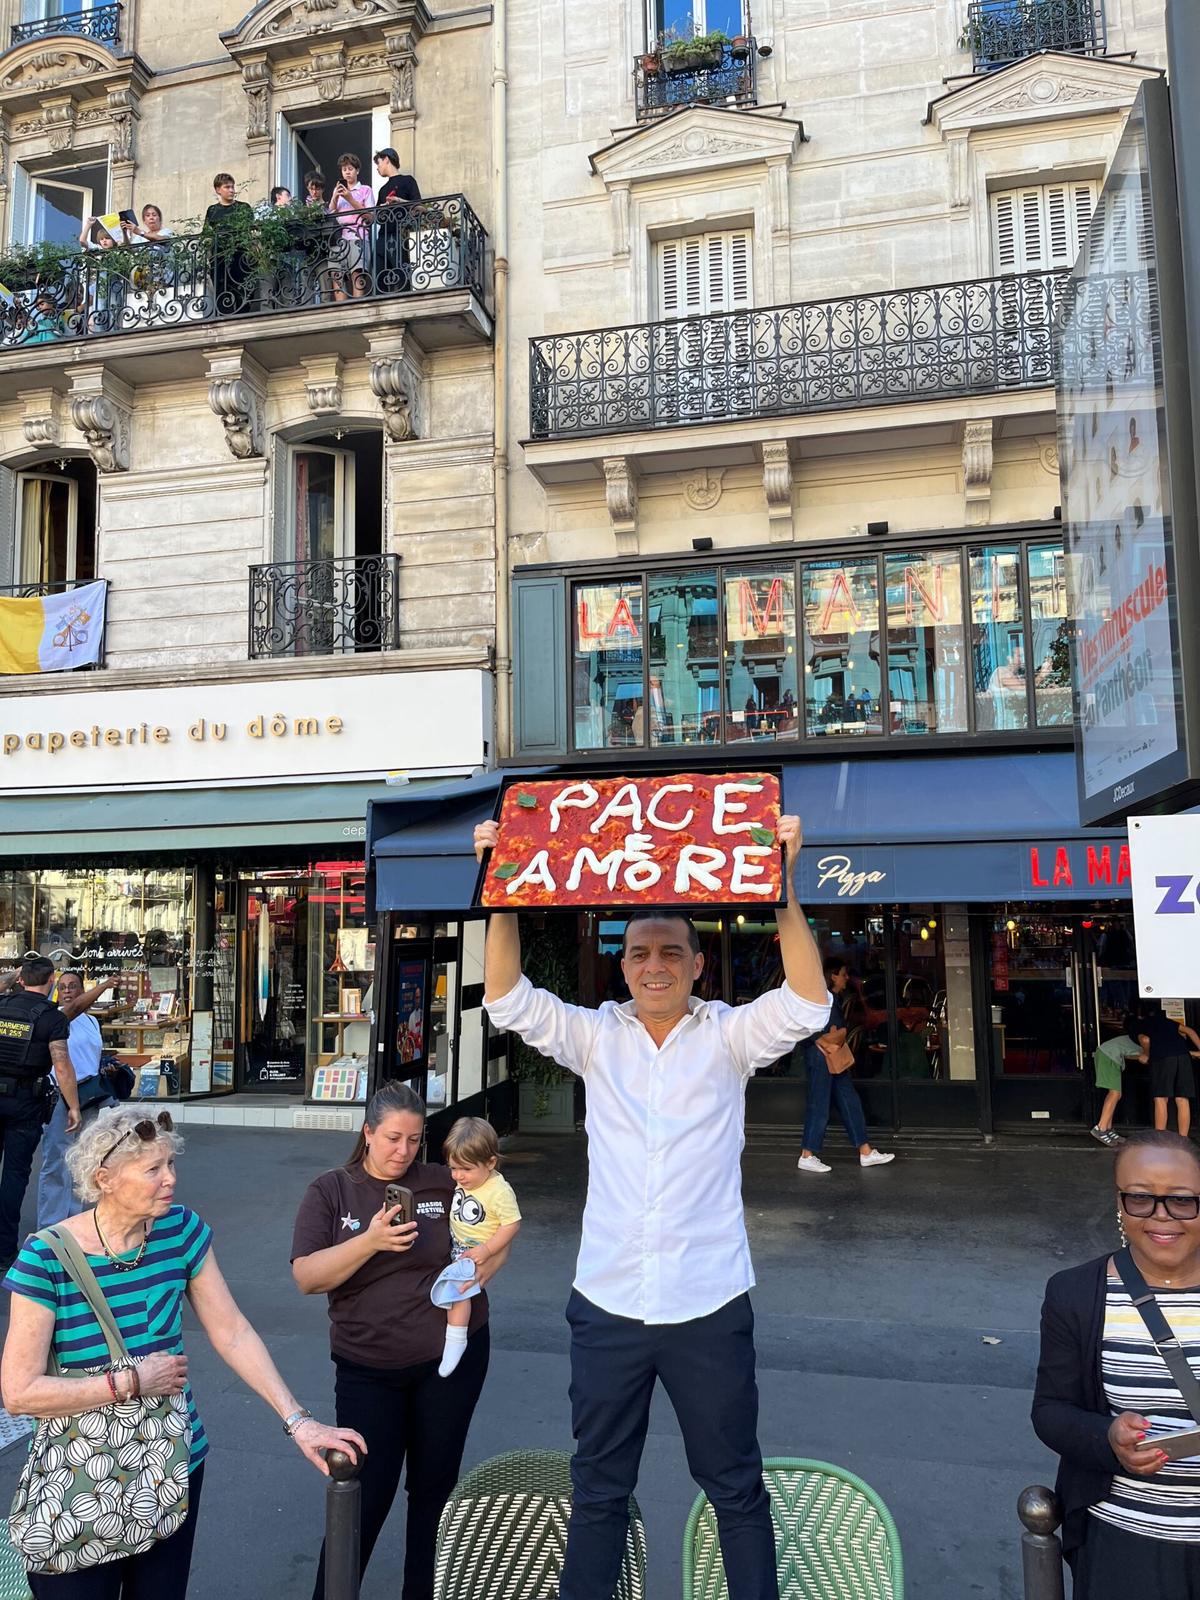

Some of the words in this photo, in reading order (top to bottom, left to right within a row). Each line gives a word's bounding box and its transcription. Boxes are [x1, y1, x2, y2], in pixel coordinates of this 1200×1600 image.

[581, 598, 639, 638] LA
[3, 722, 170, 754] papeterie
[188, 719, 226, 741] du
[247, 713, 344, 738] dôme
[550, 783, 764, 835] PACE
[1113, 781, 1135, 802] JCDecaux
[624, 833, 656, 862] E
[1030, 847, 1073, 887] LA
[506, 845, 774, 895] AMORE
[817, 855, 887, 896] Pizza
[1155, 874, 1200, 914] Z
